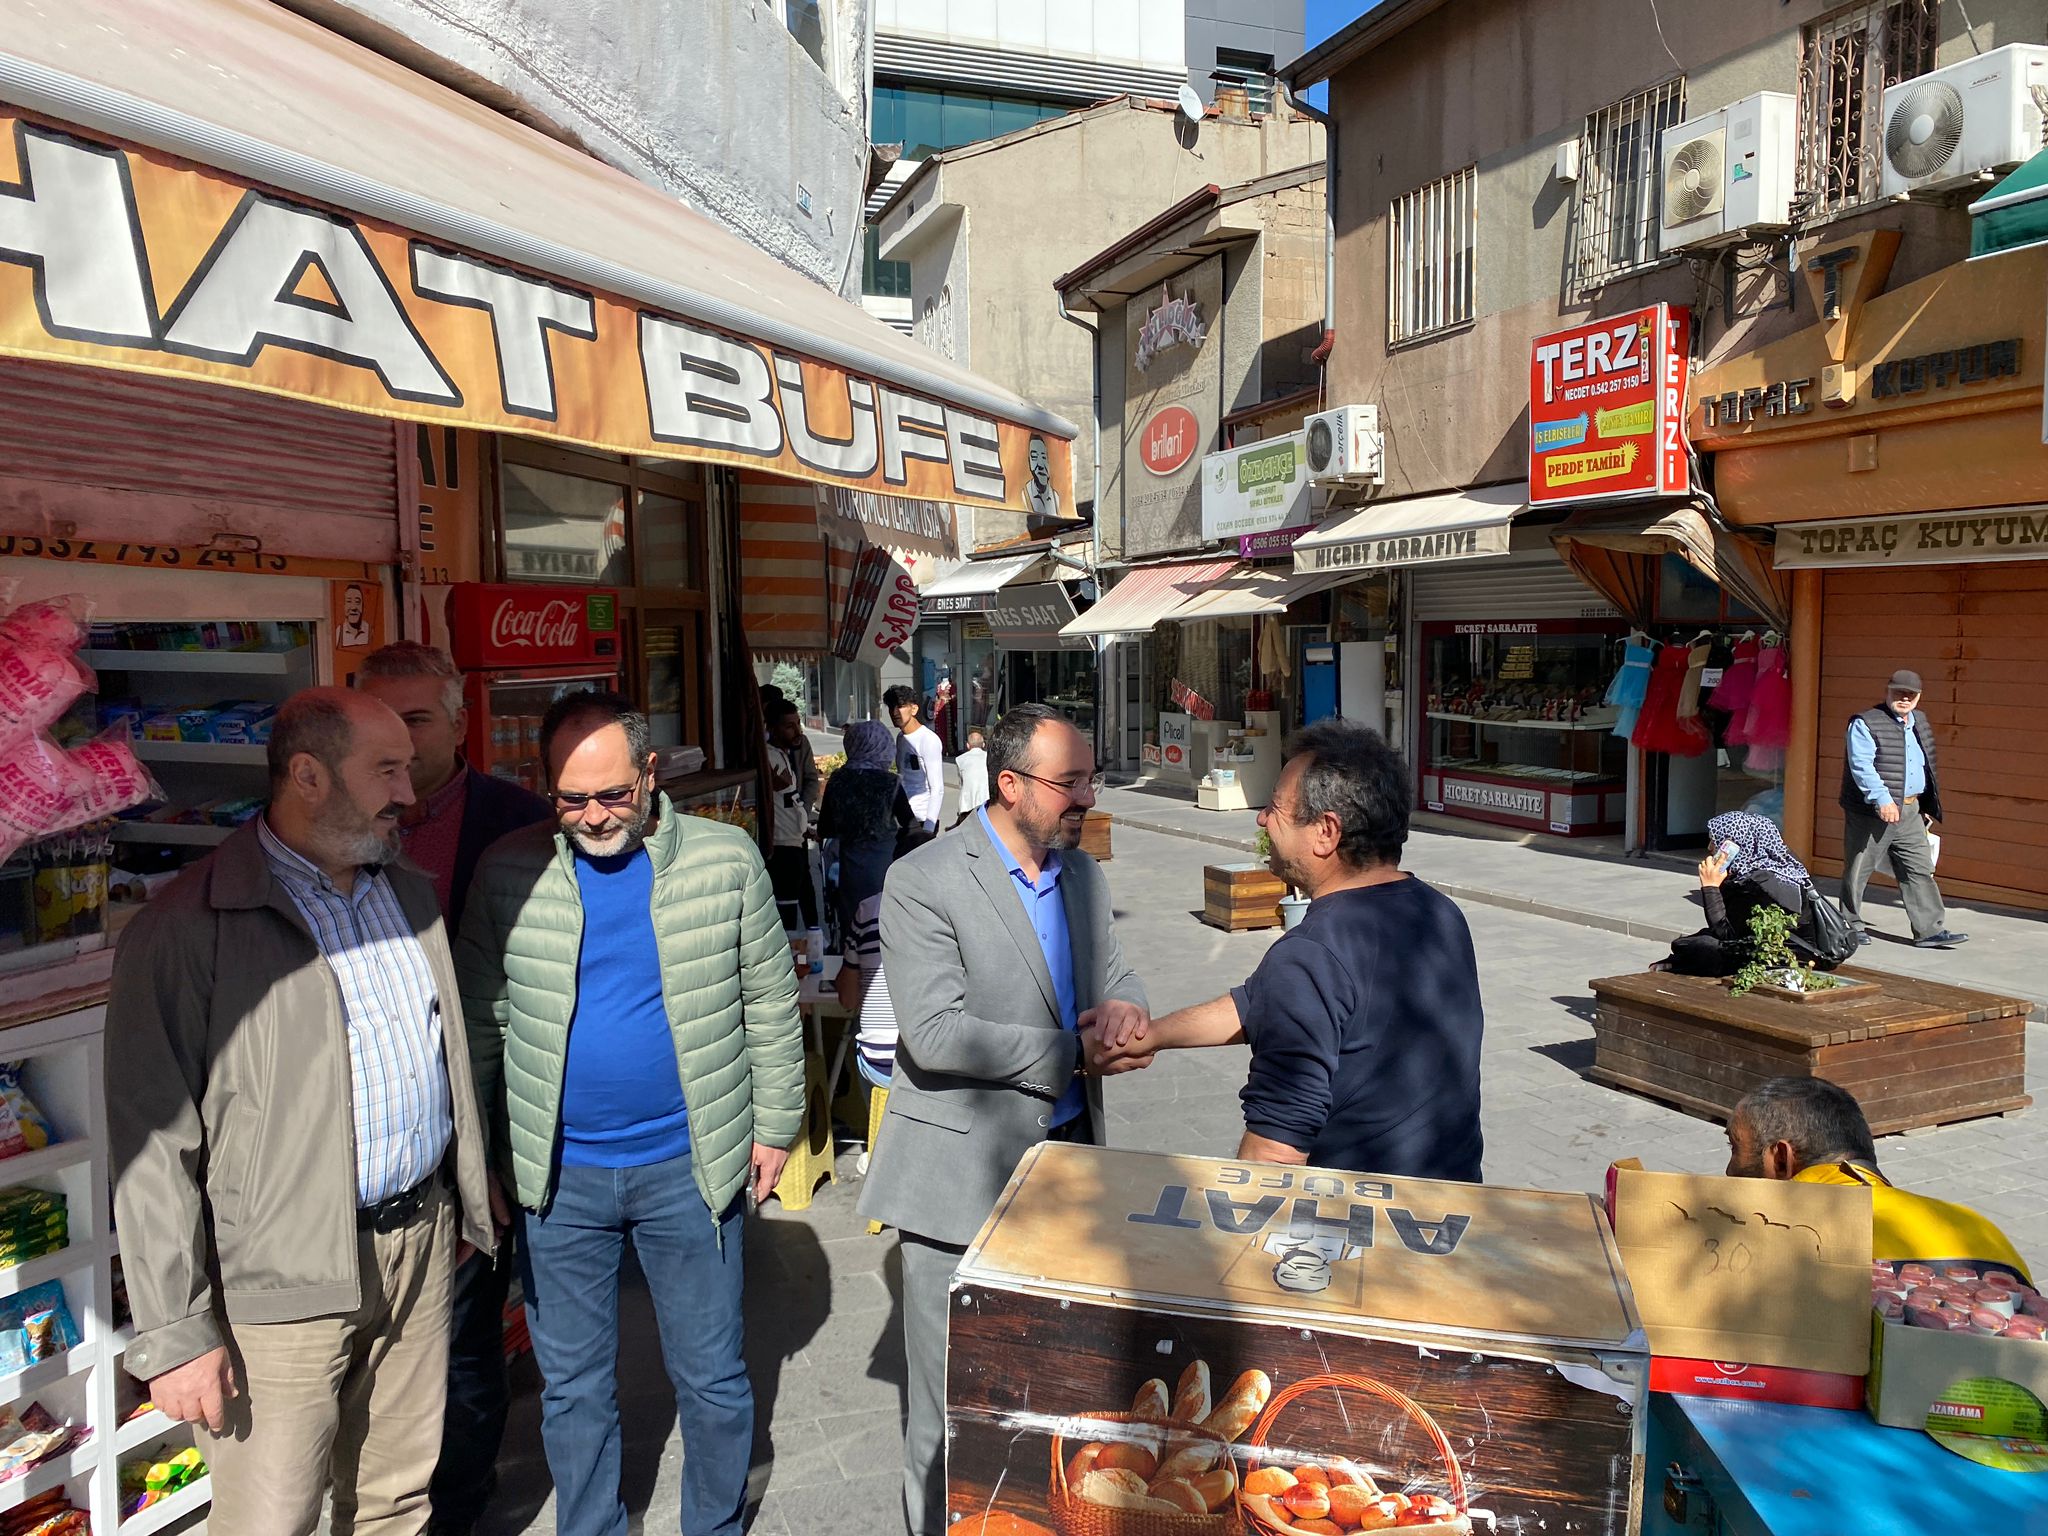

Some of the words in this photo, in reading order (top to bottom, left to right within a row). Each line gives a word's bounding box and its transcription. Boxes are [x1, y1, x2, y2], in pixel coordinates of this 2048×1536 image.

[1807, 246, 1859, 320] T
[1872, 338, 2023, 399] KUYUM
[637, 309, 1006, 502] BÜFE
[1565, 386, 1590, 401] NECDET
[1609, 379, 1621, 392] 257
[1622, 375, 1639, 389] 3150
[1336, 412, 1344, 454] arçelik
[1548, 460, 1583, 478] PERDE
[1586, 449, 1625, 472] TAMİRİ
[1801, 524, 1898, 557] TOPAÇ
[937, 598, 954, 610] ENES
[954, 597, 971, 610] SAAT
[985, 606, 1022, 627] ENES
[1022, 604, 1062, 626] SAAT
[490, 599, 581, 648] Coca-Cola
[1216, 1166, 1395, 1200] BÜFE
[1126, 1184, 1473, 1256] AHAT
